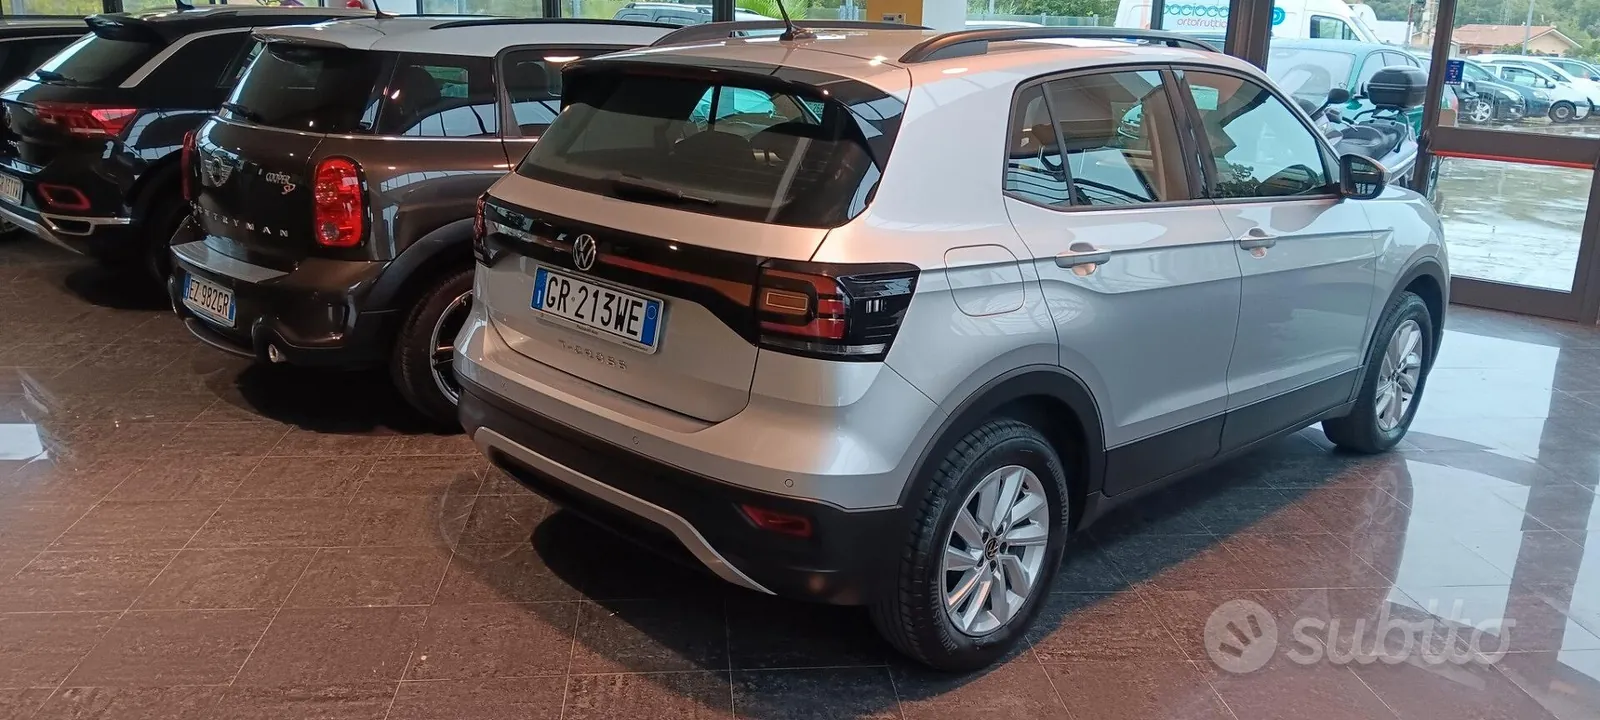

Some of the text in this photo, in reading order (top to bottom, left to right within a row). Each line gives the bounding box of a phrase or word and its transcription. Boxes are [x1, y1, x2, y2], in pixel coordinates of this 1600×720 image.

[189, 279, 230, 316] EZ 982GR
[545, 276, 643, 336] GR 213WE
